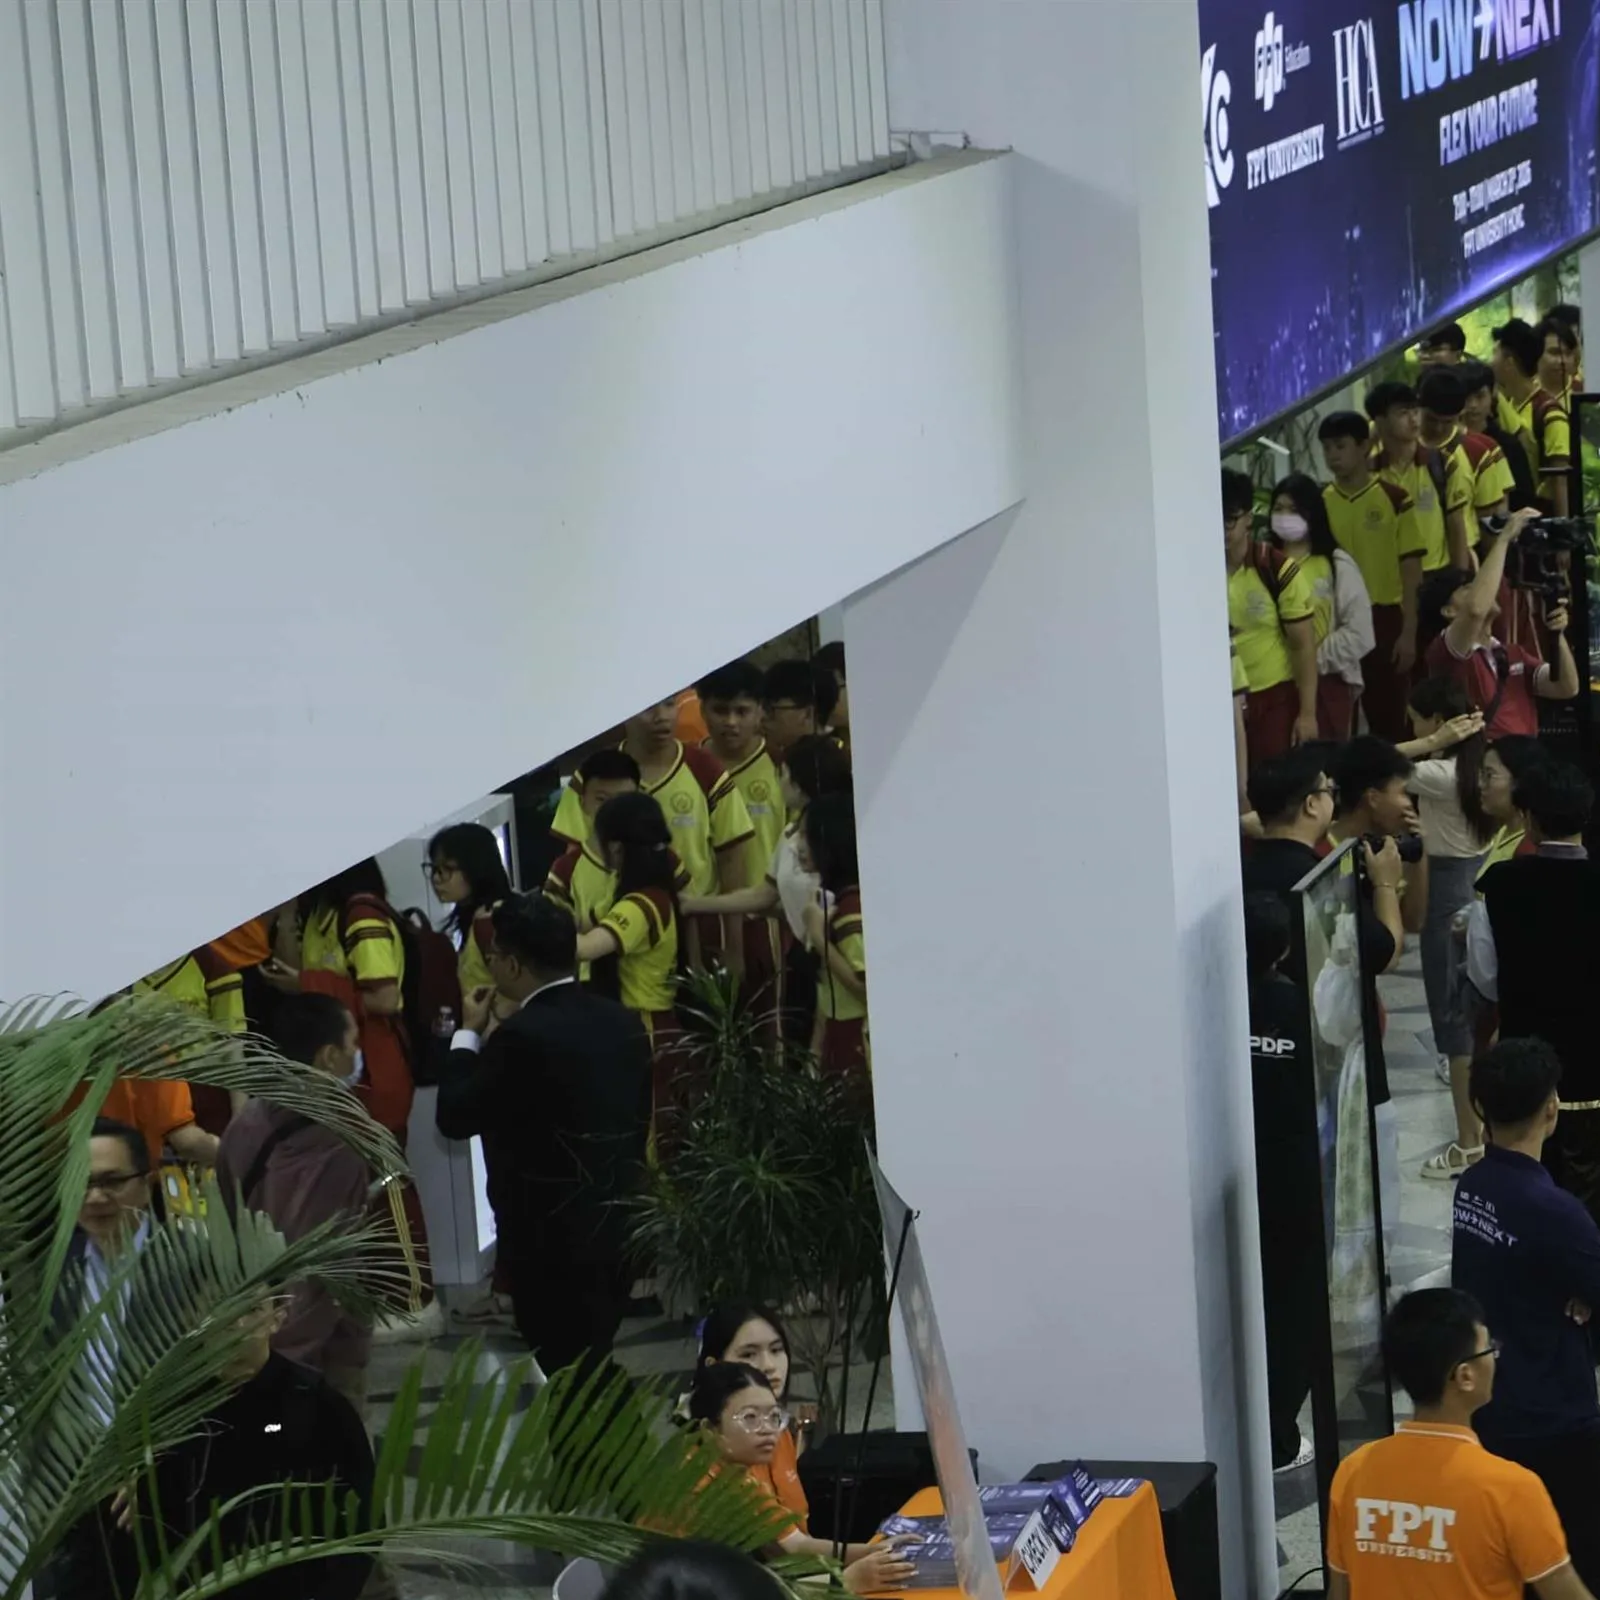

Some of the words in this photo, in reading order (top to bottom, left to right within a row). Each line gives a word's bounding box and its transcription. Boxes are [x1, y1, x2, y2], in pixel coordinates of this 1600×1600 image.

[1333, 17, 1385, 141] HCA
[1398, 0, 1474, 99] NOW
[1267, 123, 1324, 181] UNIVERSITY
[1439, 108, 1467, 166] FLEX
[1467, 95, 1499, 152] YOUR
[1499, 77, 1538, 139] FUTURE
[1355, 1497, 1456, 1550] FPT
[1355, 1540, 1455, 1563] UNIVERSITY
